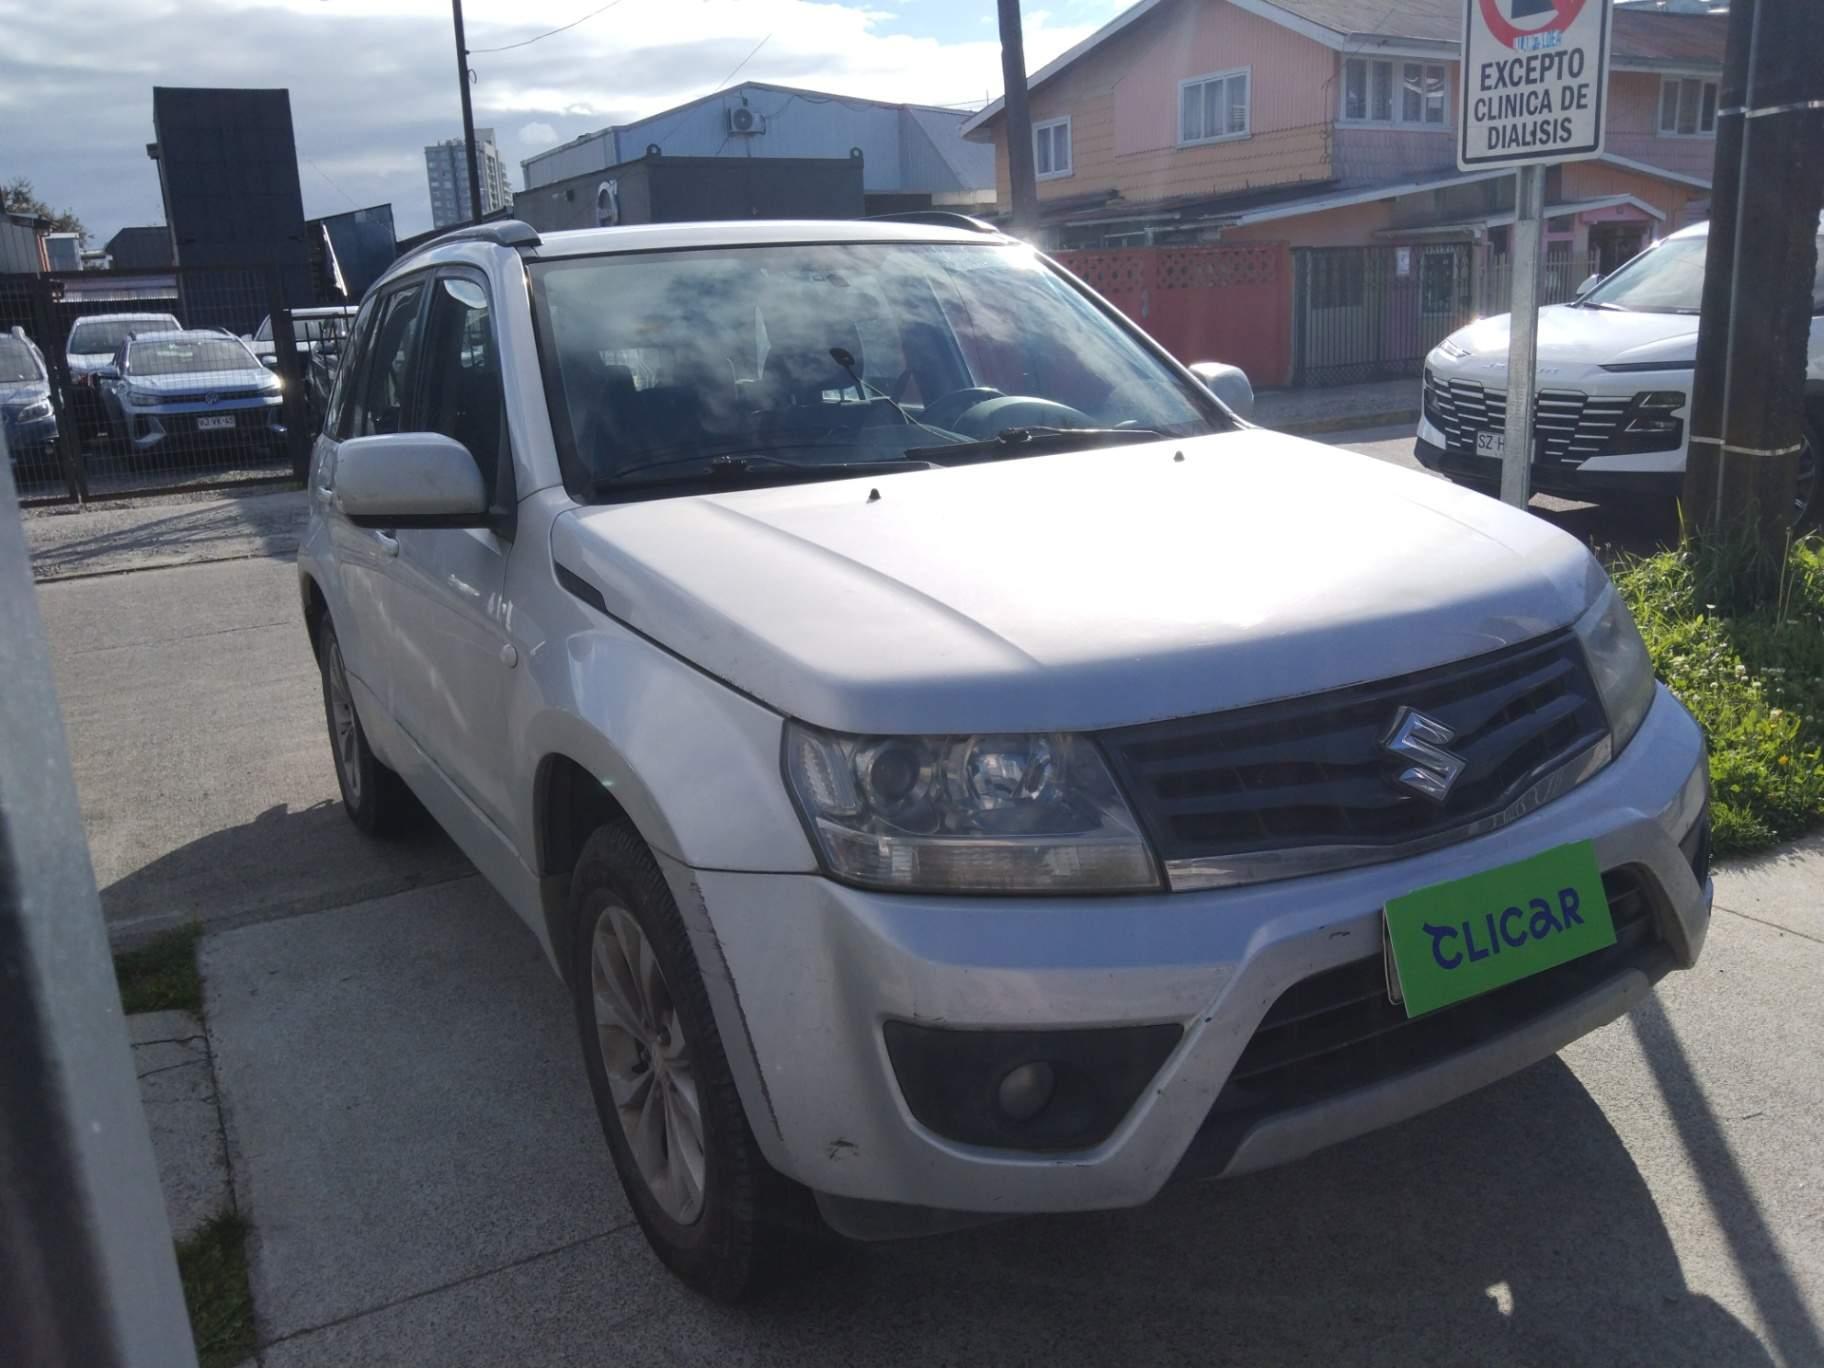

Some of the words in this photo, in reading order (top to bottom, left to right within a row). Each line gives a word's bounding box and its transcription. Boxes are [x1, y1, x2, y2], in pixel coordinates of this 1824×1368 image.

[1480, 48, 1585, 92] EXCEPTO
[1474, 89, 1552, 122] CLINICA
[1560, 83, 1590, 112] DE
[1487, 117, 1573, 150] DIALISIS
